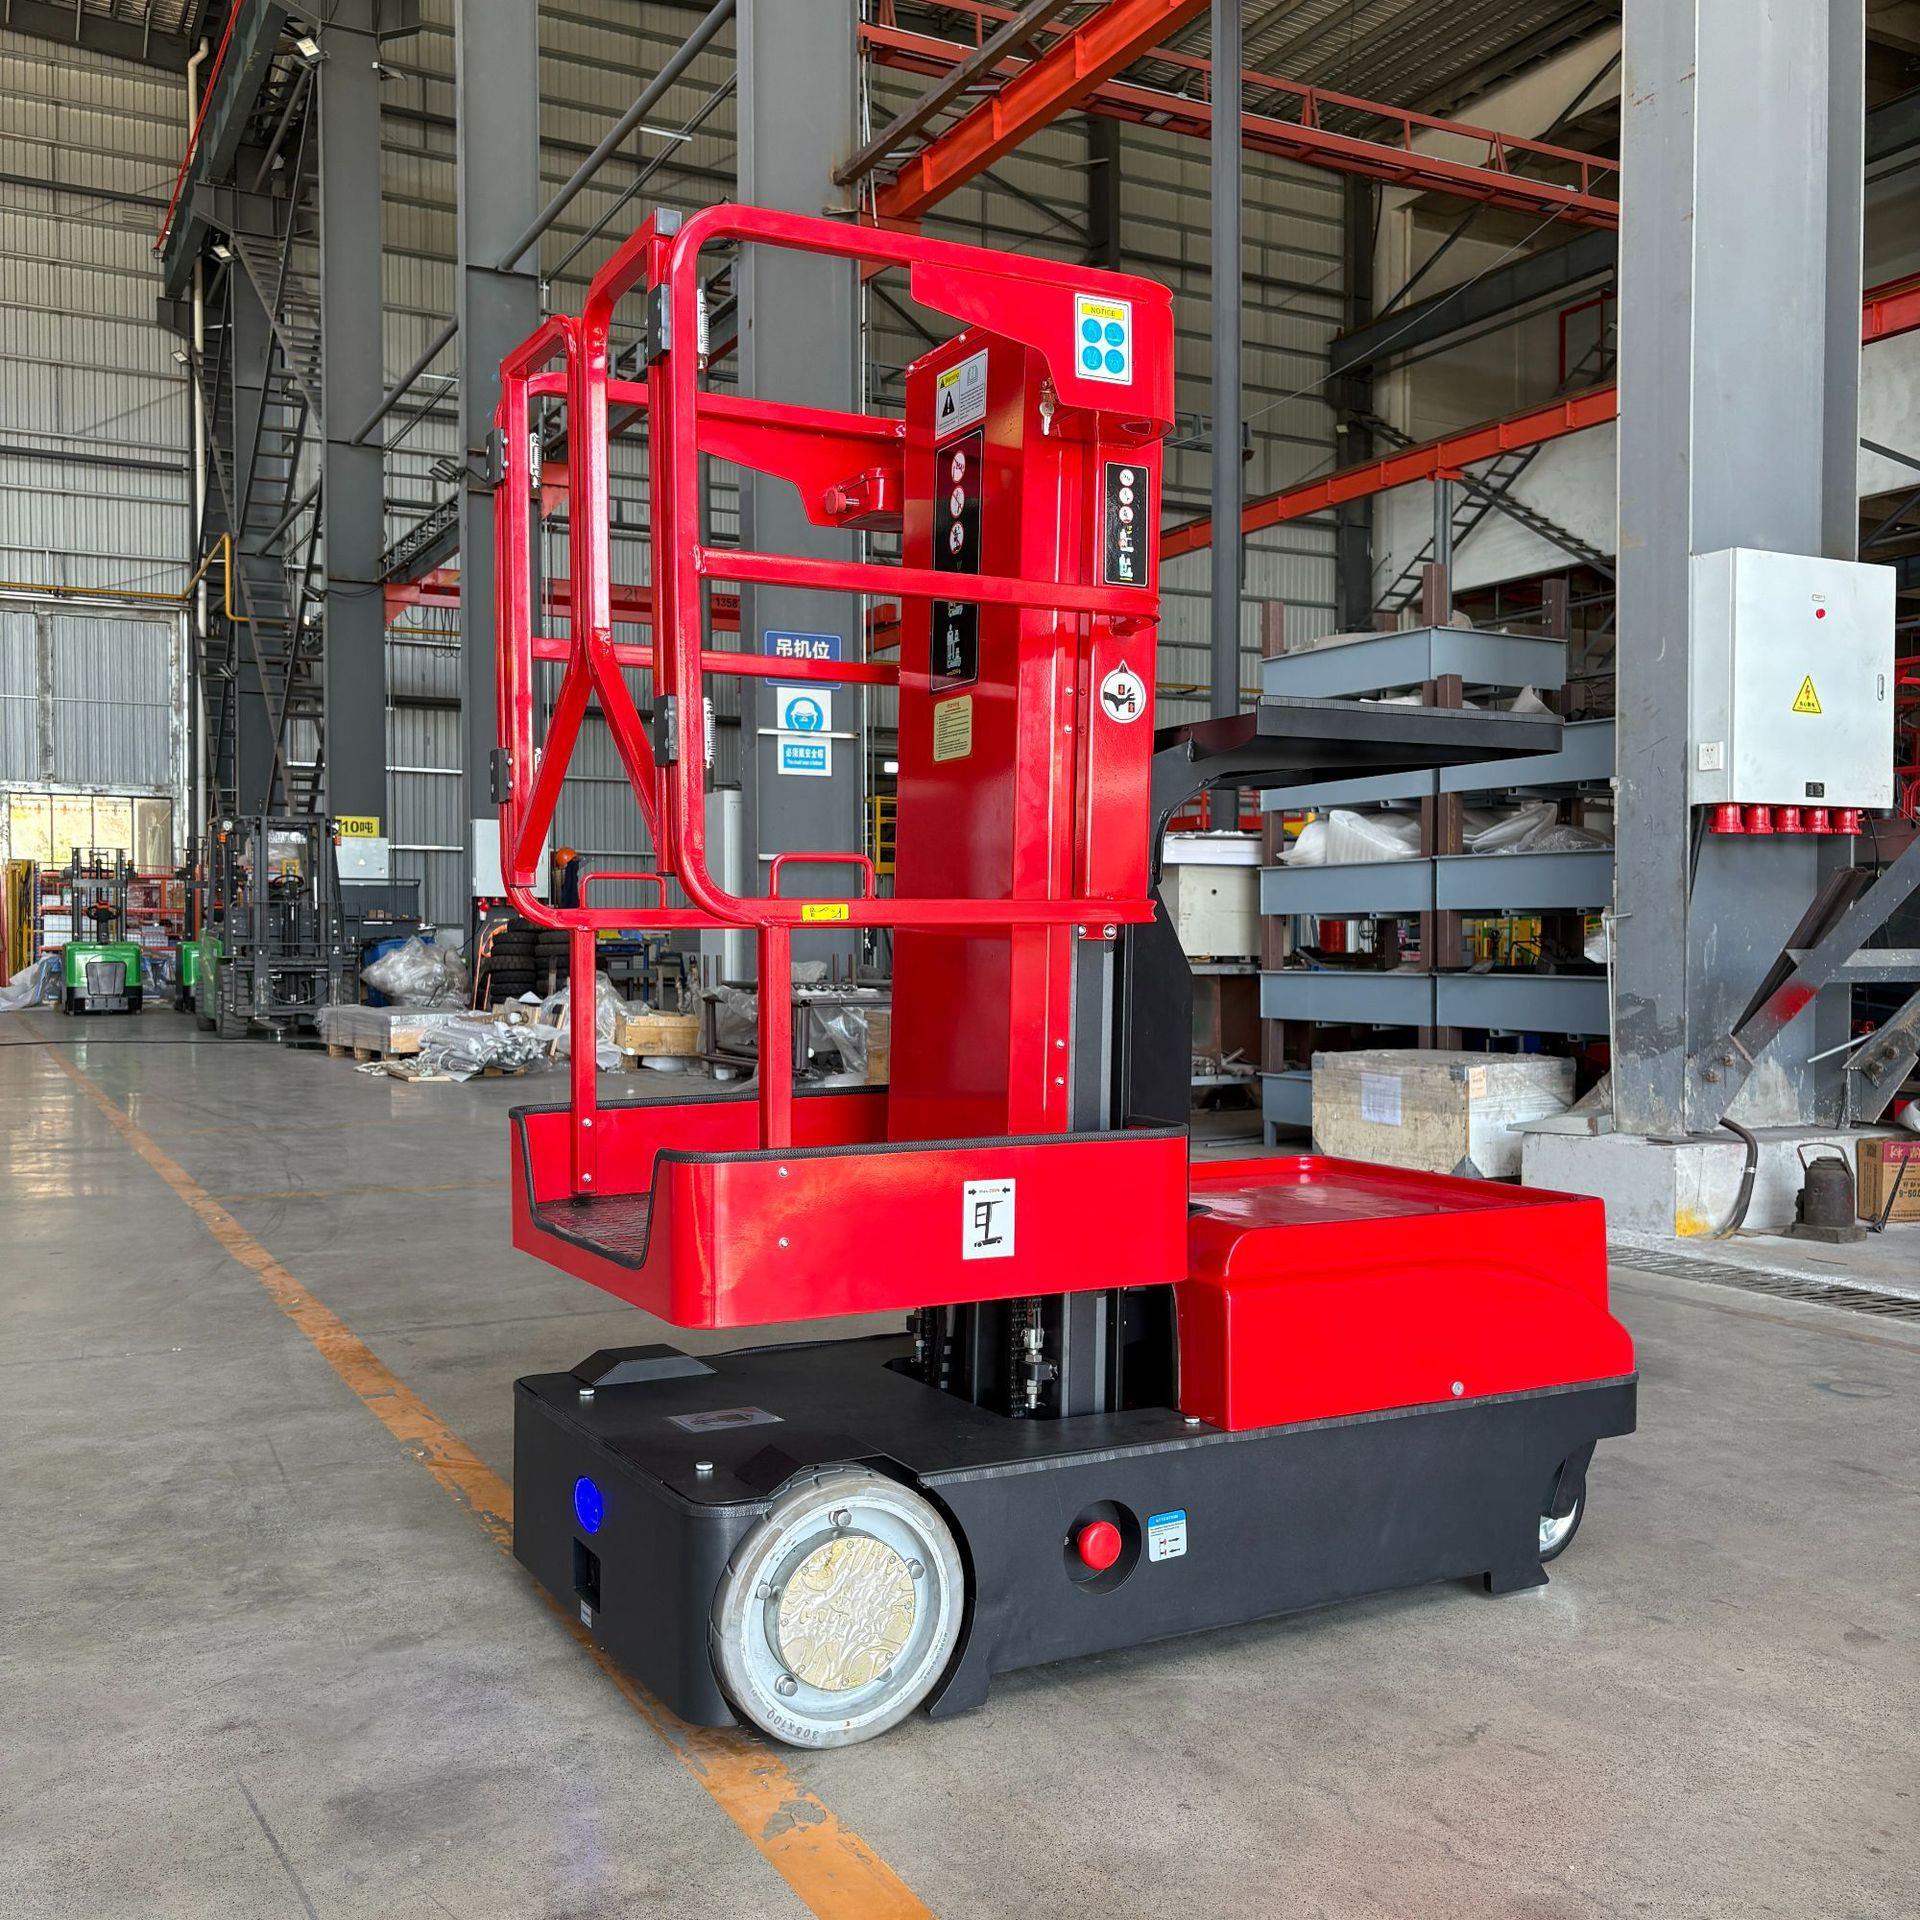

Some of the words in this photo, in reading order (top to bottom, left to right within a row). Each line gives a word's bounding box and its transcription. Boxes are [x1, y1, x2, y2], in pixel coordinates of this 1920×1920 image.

[1090, 306, 1115, 317] NOTICE
[776, 638, 831, 660] 吊机位
[342, 820, 374, 833] 10吨
